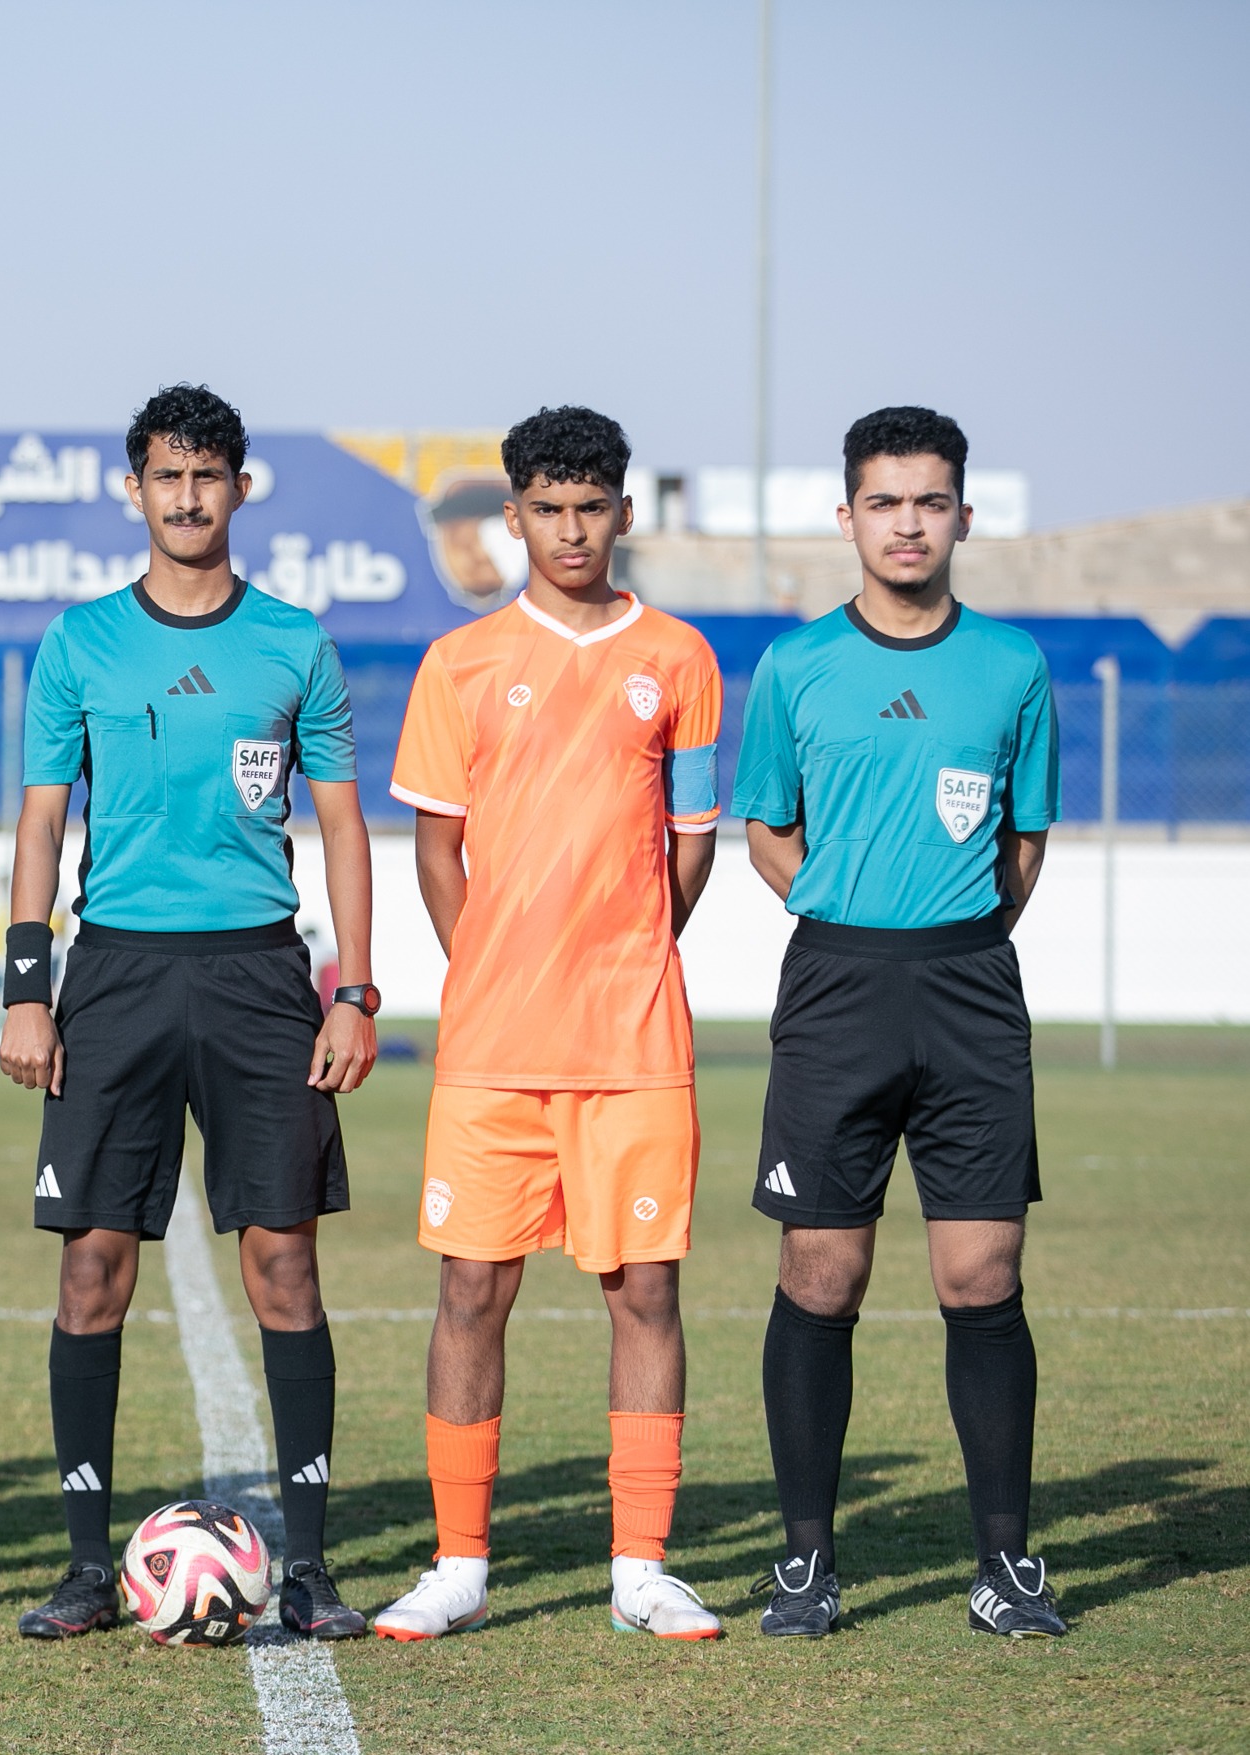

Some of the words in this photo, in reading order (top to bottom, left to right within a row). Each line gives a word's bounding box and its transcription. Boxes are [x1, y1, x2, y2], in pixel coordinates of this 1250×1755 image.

[239, 749, 279, 767] SAFF
[241, 770, 274, 780] REFEREE
[943, 778, 987, 799] SAFF
[946, 799, 981, 812] REFEREE
